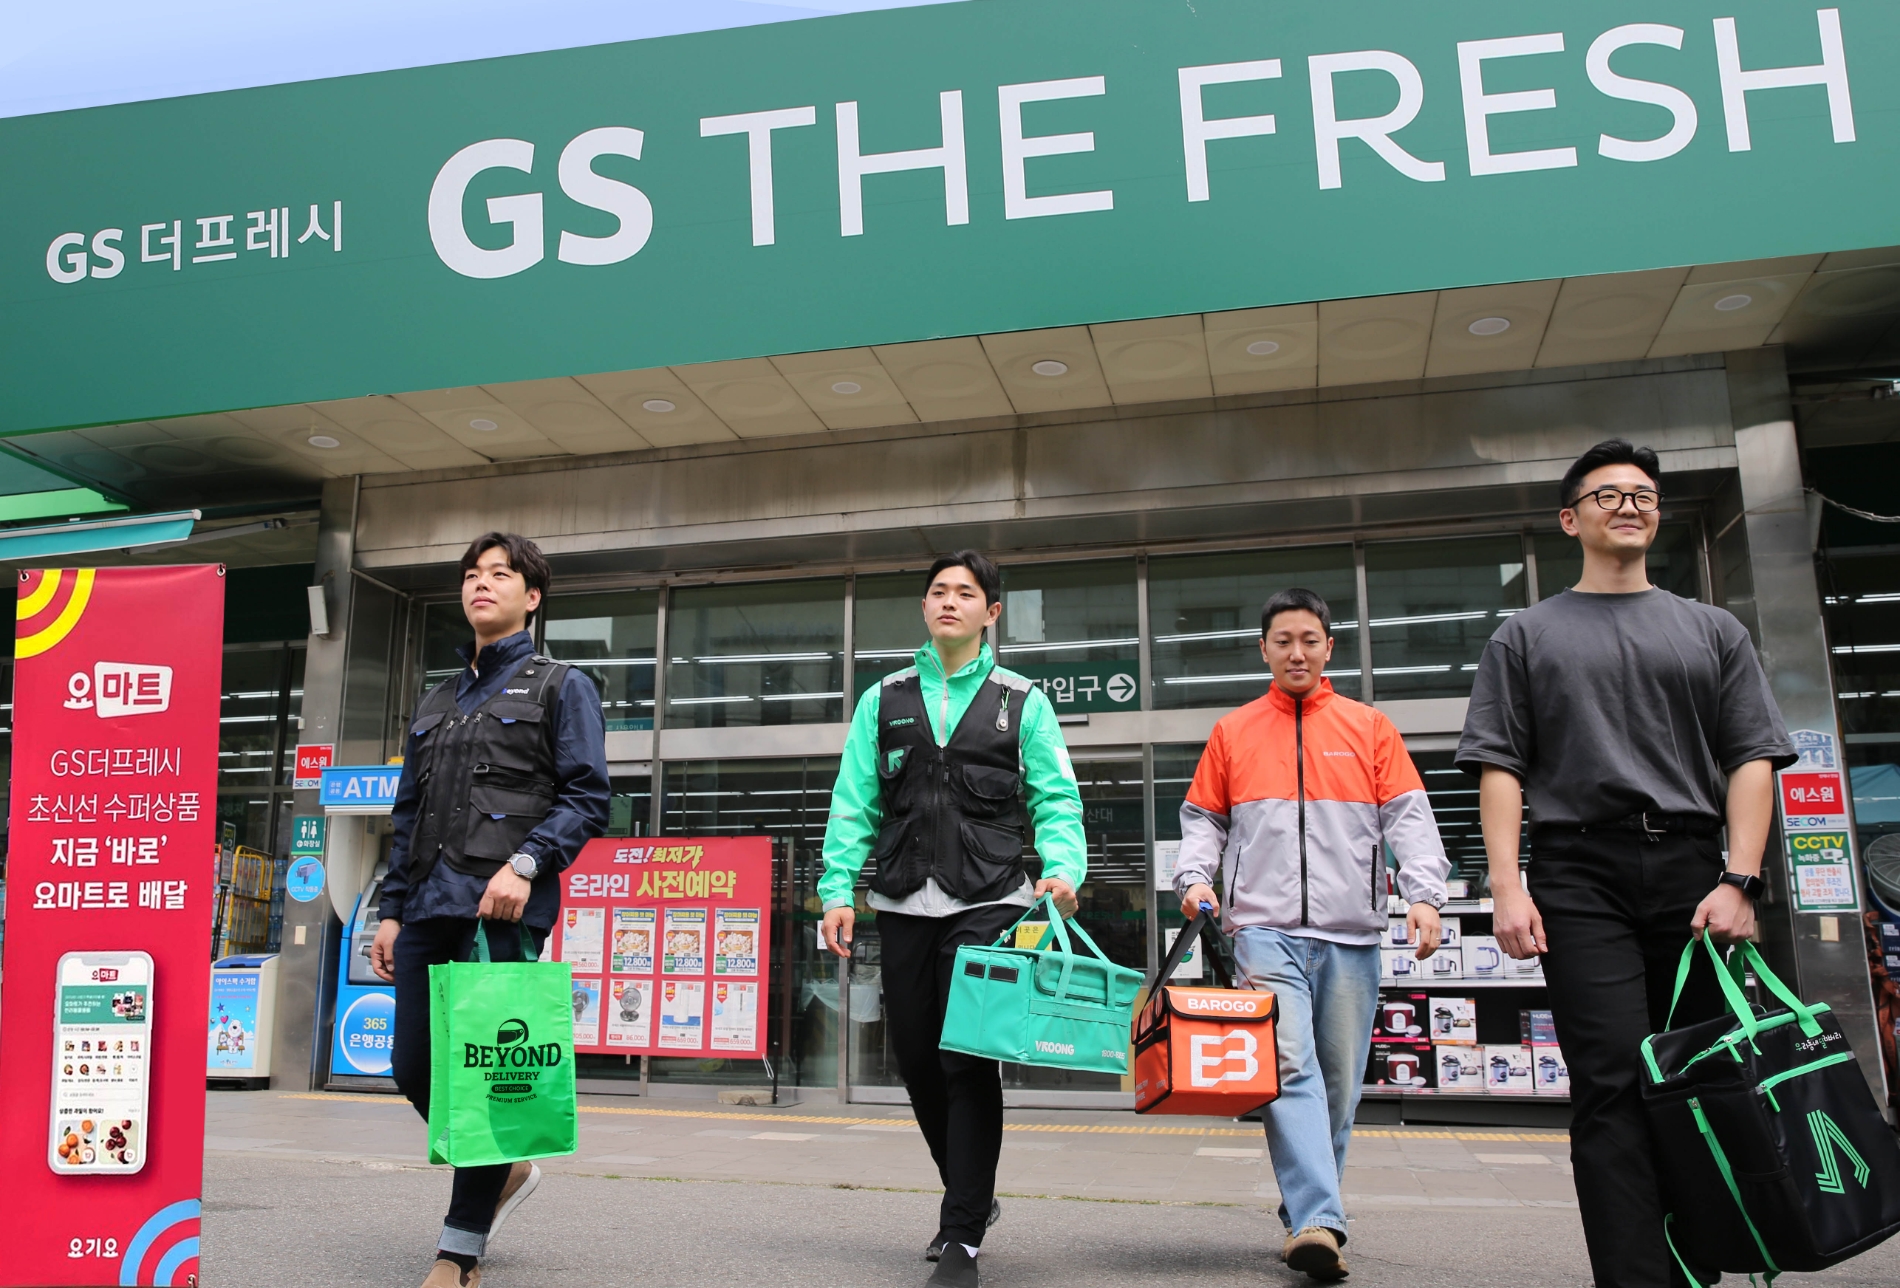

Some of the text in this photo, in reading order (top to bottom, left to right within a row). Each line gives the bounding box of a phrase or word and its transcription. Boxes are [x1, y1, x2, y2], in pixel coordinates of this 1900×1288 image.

[427, 7, 1857, 279] GS THE FRESH
[46, 200, 342, 284] GS 더프레시
[63, 671, 163, 710] 요마트
[51, 747, 181, 778] GS더프레시
[300, 756, 328, 769] 에스원
[294, 779, 319, 788] SECOM
[343, 776, 400, 798] ATM
[1789, 786, 1835, 803] 에스원
[27, 793, 98, 824] 초신선
[103, 791, 201, 823] 수퍼상품
[1083, 807, 1113, 823] 산대
[1786, 816, 1827, 827] SECOM
[51, 837, 99, 867] 지금
[1793, 835, 1845, 850] CCTV
[569, 870, 737, 899] 온라인 사전예약
[33, 880, 188, 911] 요마트로 배달
[1187, 998, 1257, 1013] BAROGO
[363, 1017, 387, 1030] 365
[463, 1042, 562, 1068] BEYOND
[1035, 1040, 1075, 1055] VROONG
[484, 1071, 541, 1081] DELIVERY
[485, 1093, 538, 1104] PREMIUM SERVICE
[67, 1237, 119, 1259] 요기요
